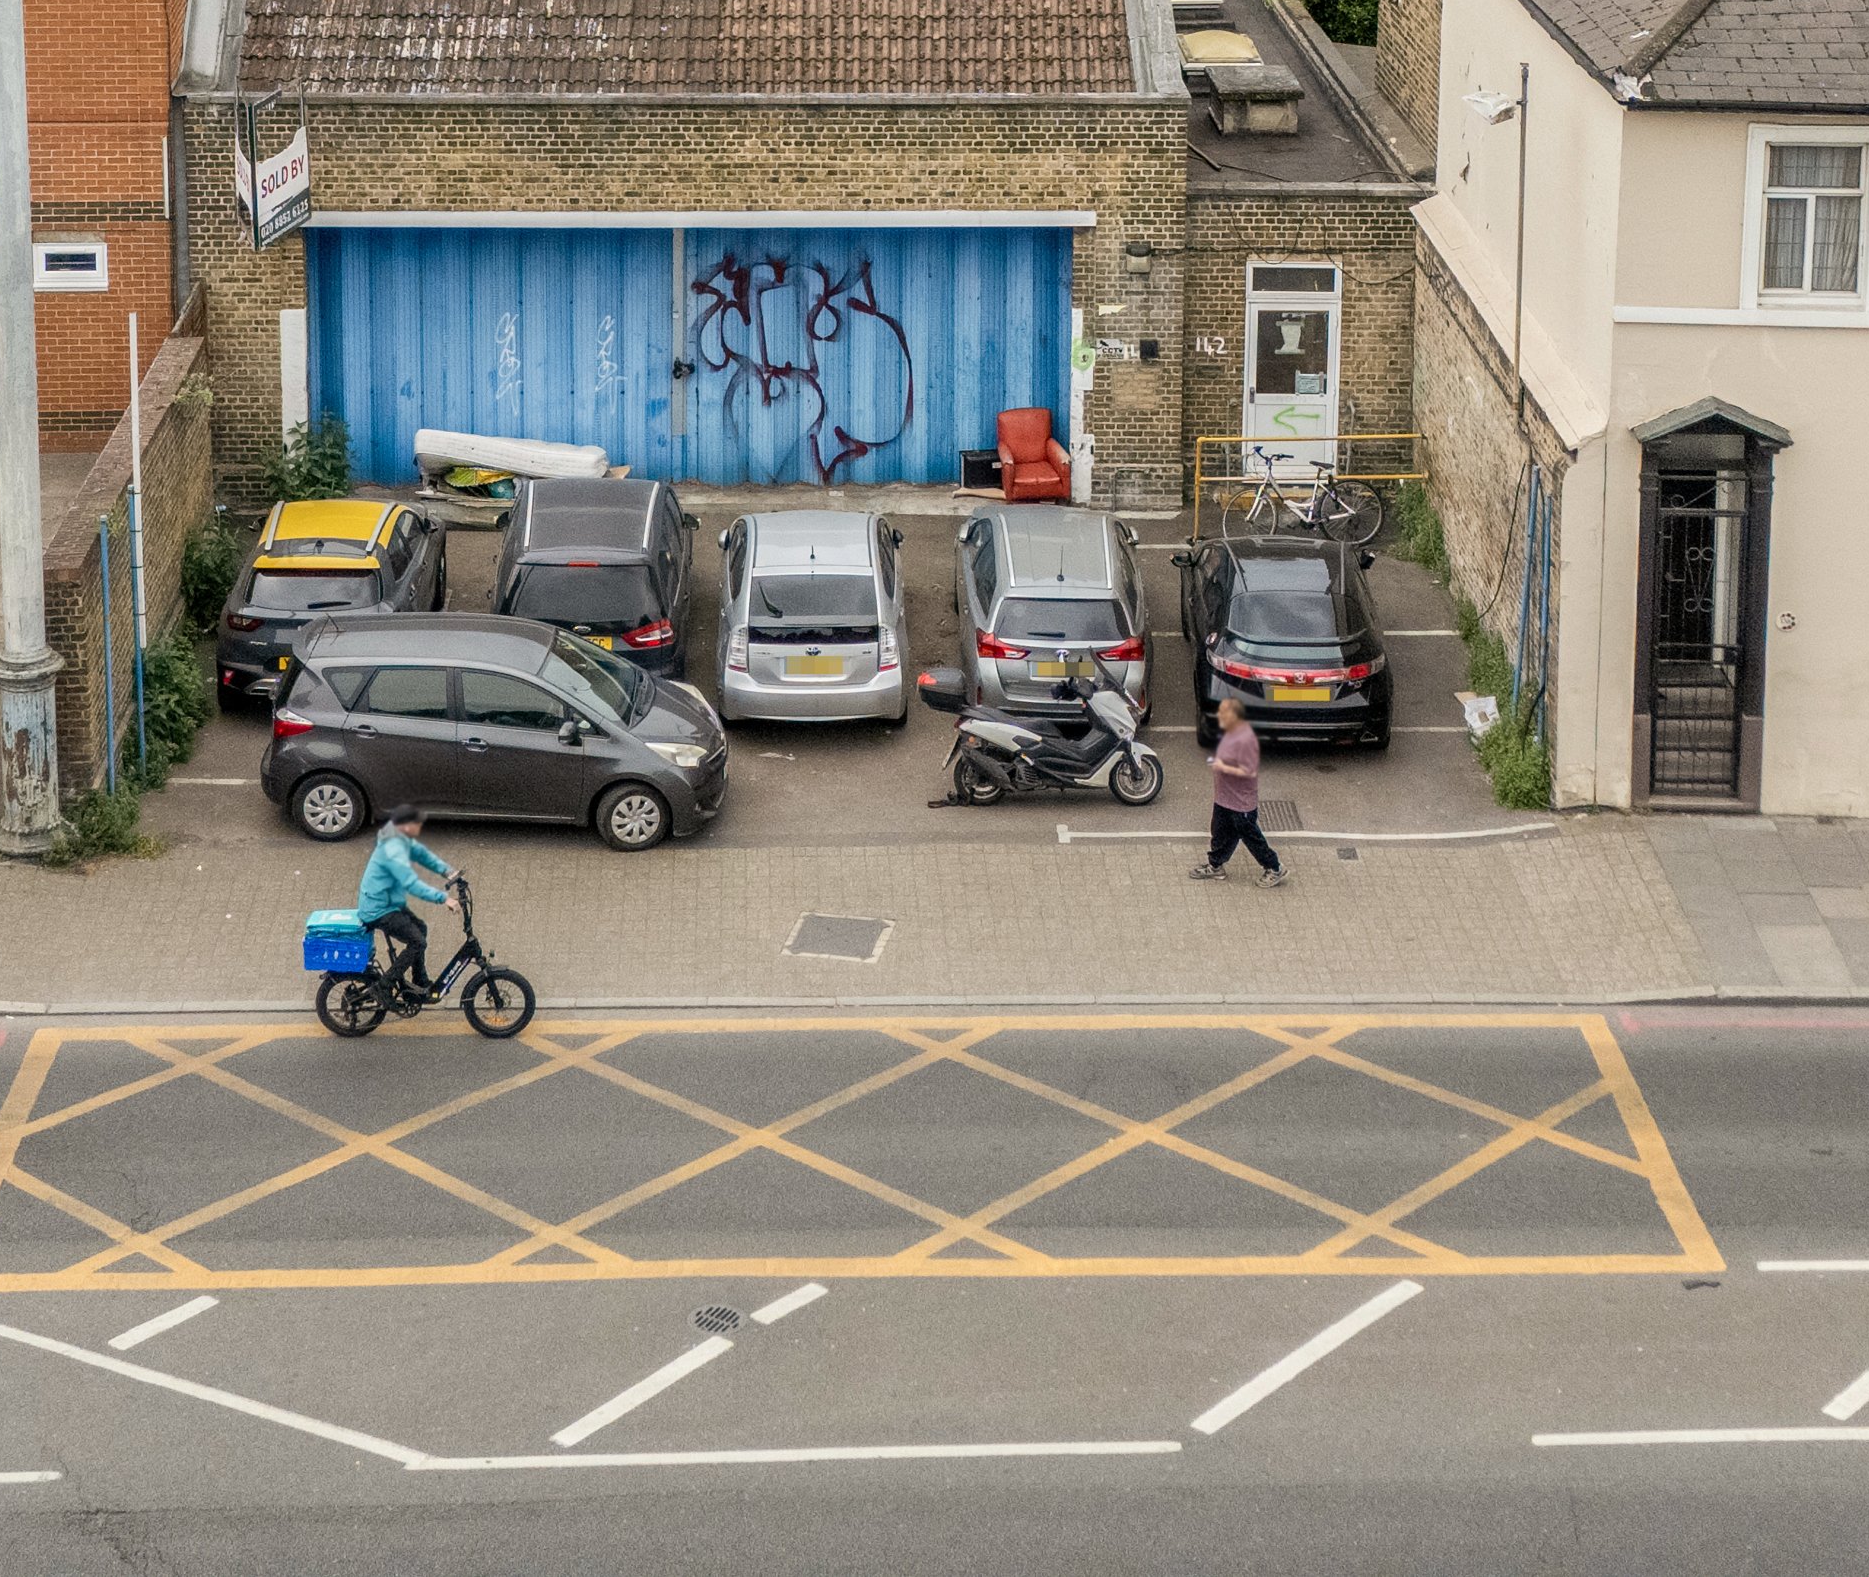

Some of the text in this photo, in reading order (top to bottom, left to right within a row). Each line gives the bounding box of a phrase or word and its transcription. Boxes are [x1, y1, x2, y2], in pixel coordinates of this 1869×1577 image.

[261, 155, 305, 199] SOLD BY
[1195, 336, 1227, 356] 142
